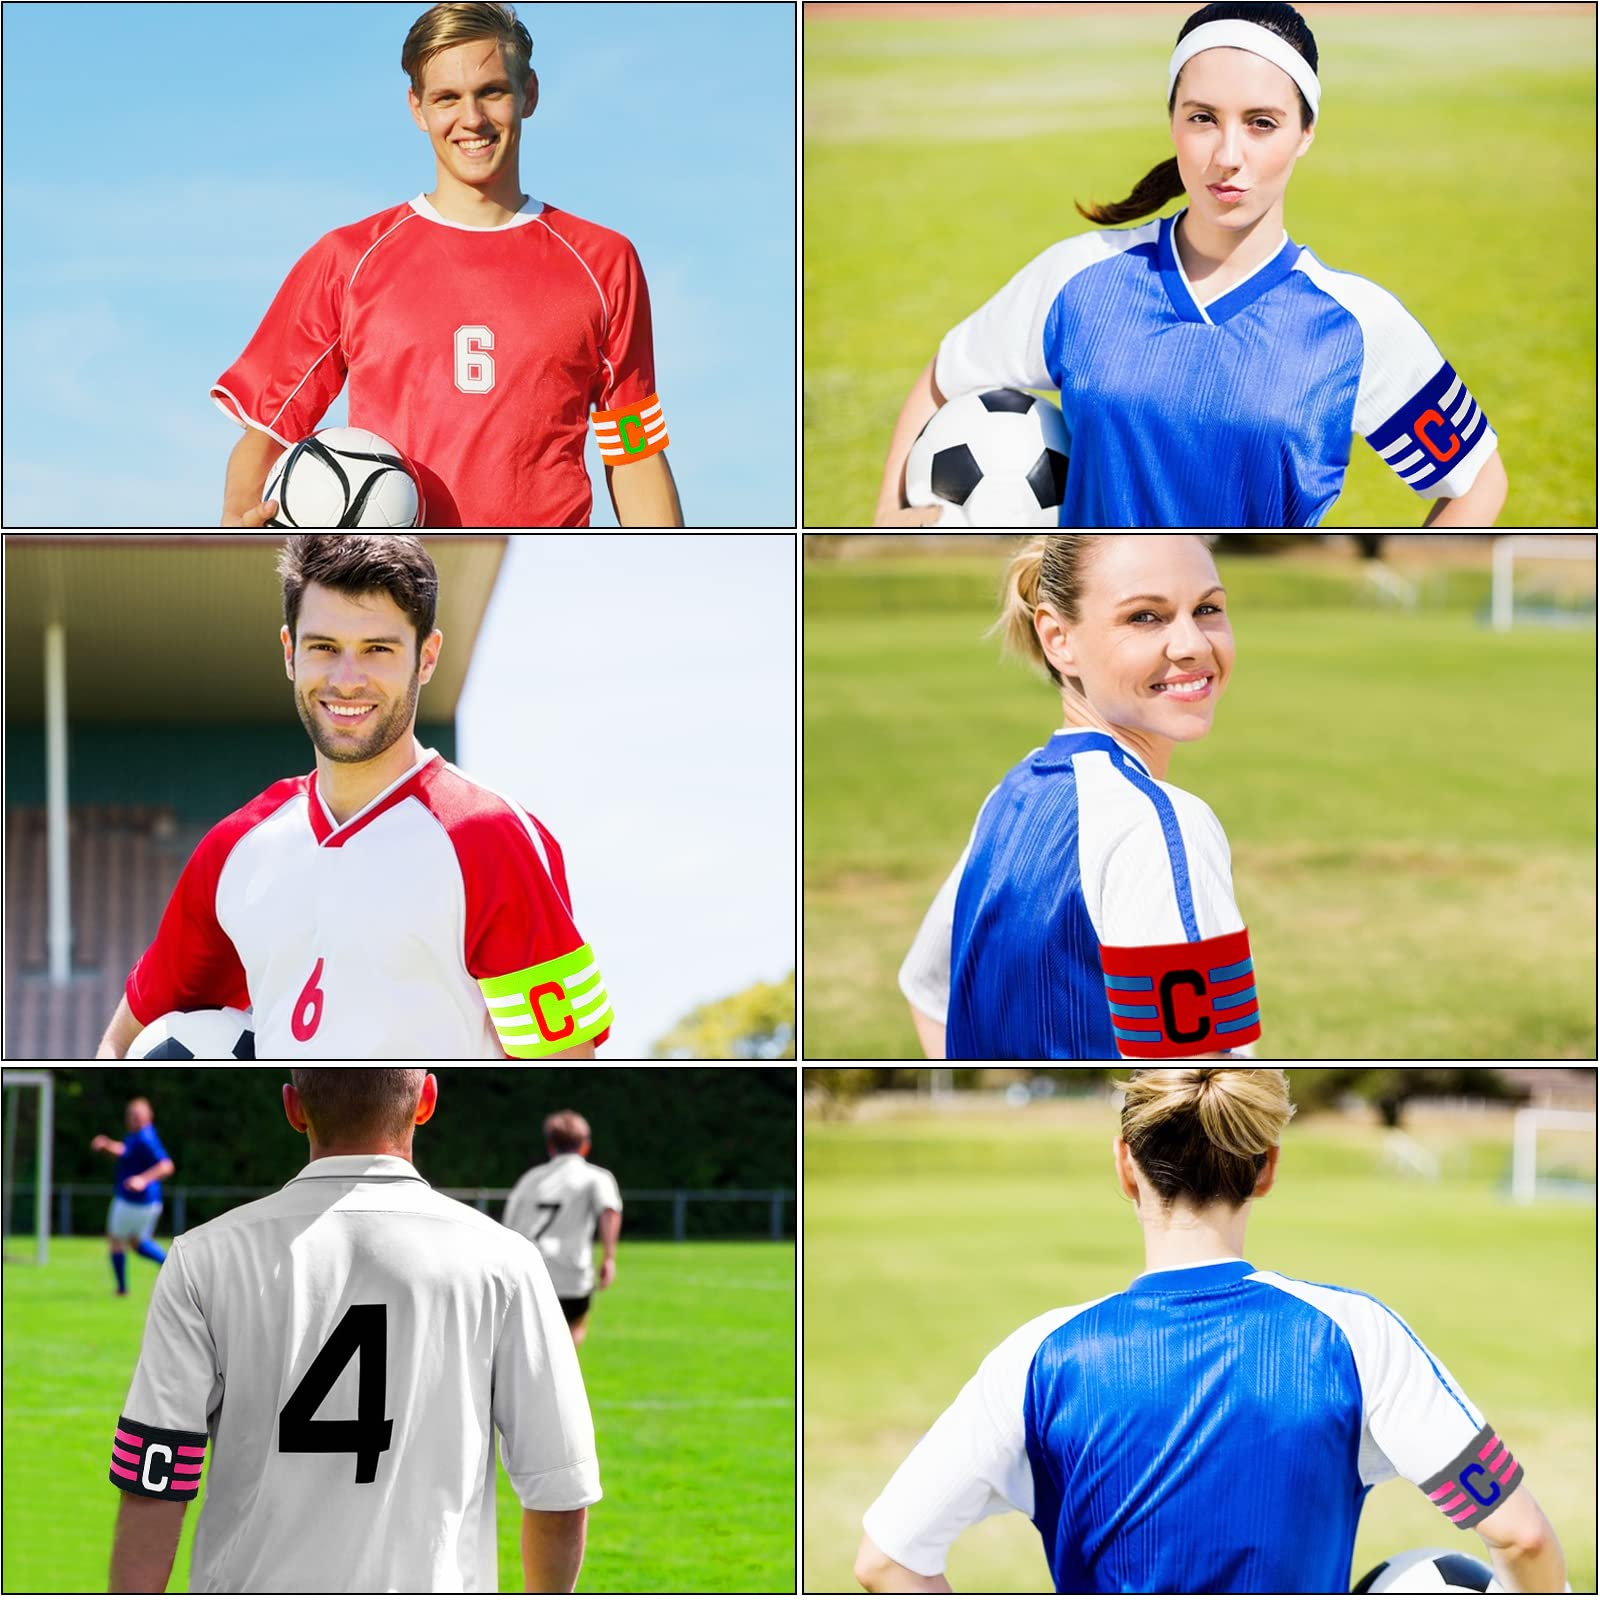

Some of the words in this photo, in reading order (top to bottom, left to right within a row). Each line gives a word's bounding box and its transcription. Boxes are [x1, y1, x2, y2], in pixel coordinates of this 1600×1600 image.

[454, 325, 496, 394] 6
[618, 414, 647, 455] C
[1413, 408, 1461, 463] C
[290, 957, 325, 1043] 6
[528, 981, 575, 1042] C
[1159, 969, 1211, 1044] C
[536, 1202, 561, 1241] 7
[278, 1303, 394, 1484] 4
[141, 1442, 173, 1493] C
[1458, 1462, 1501, 1507] C
